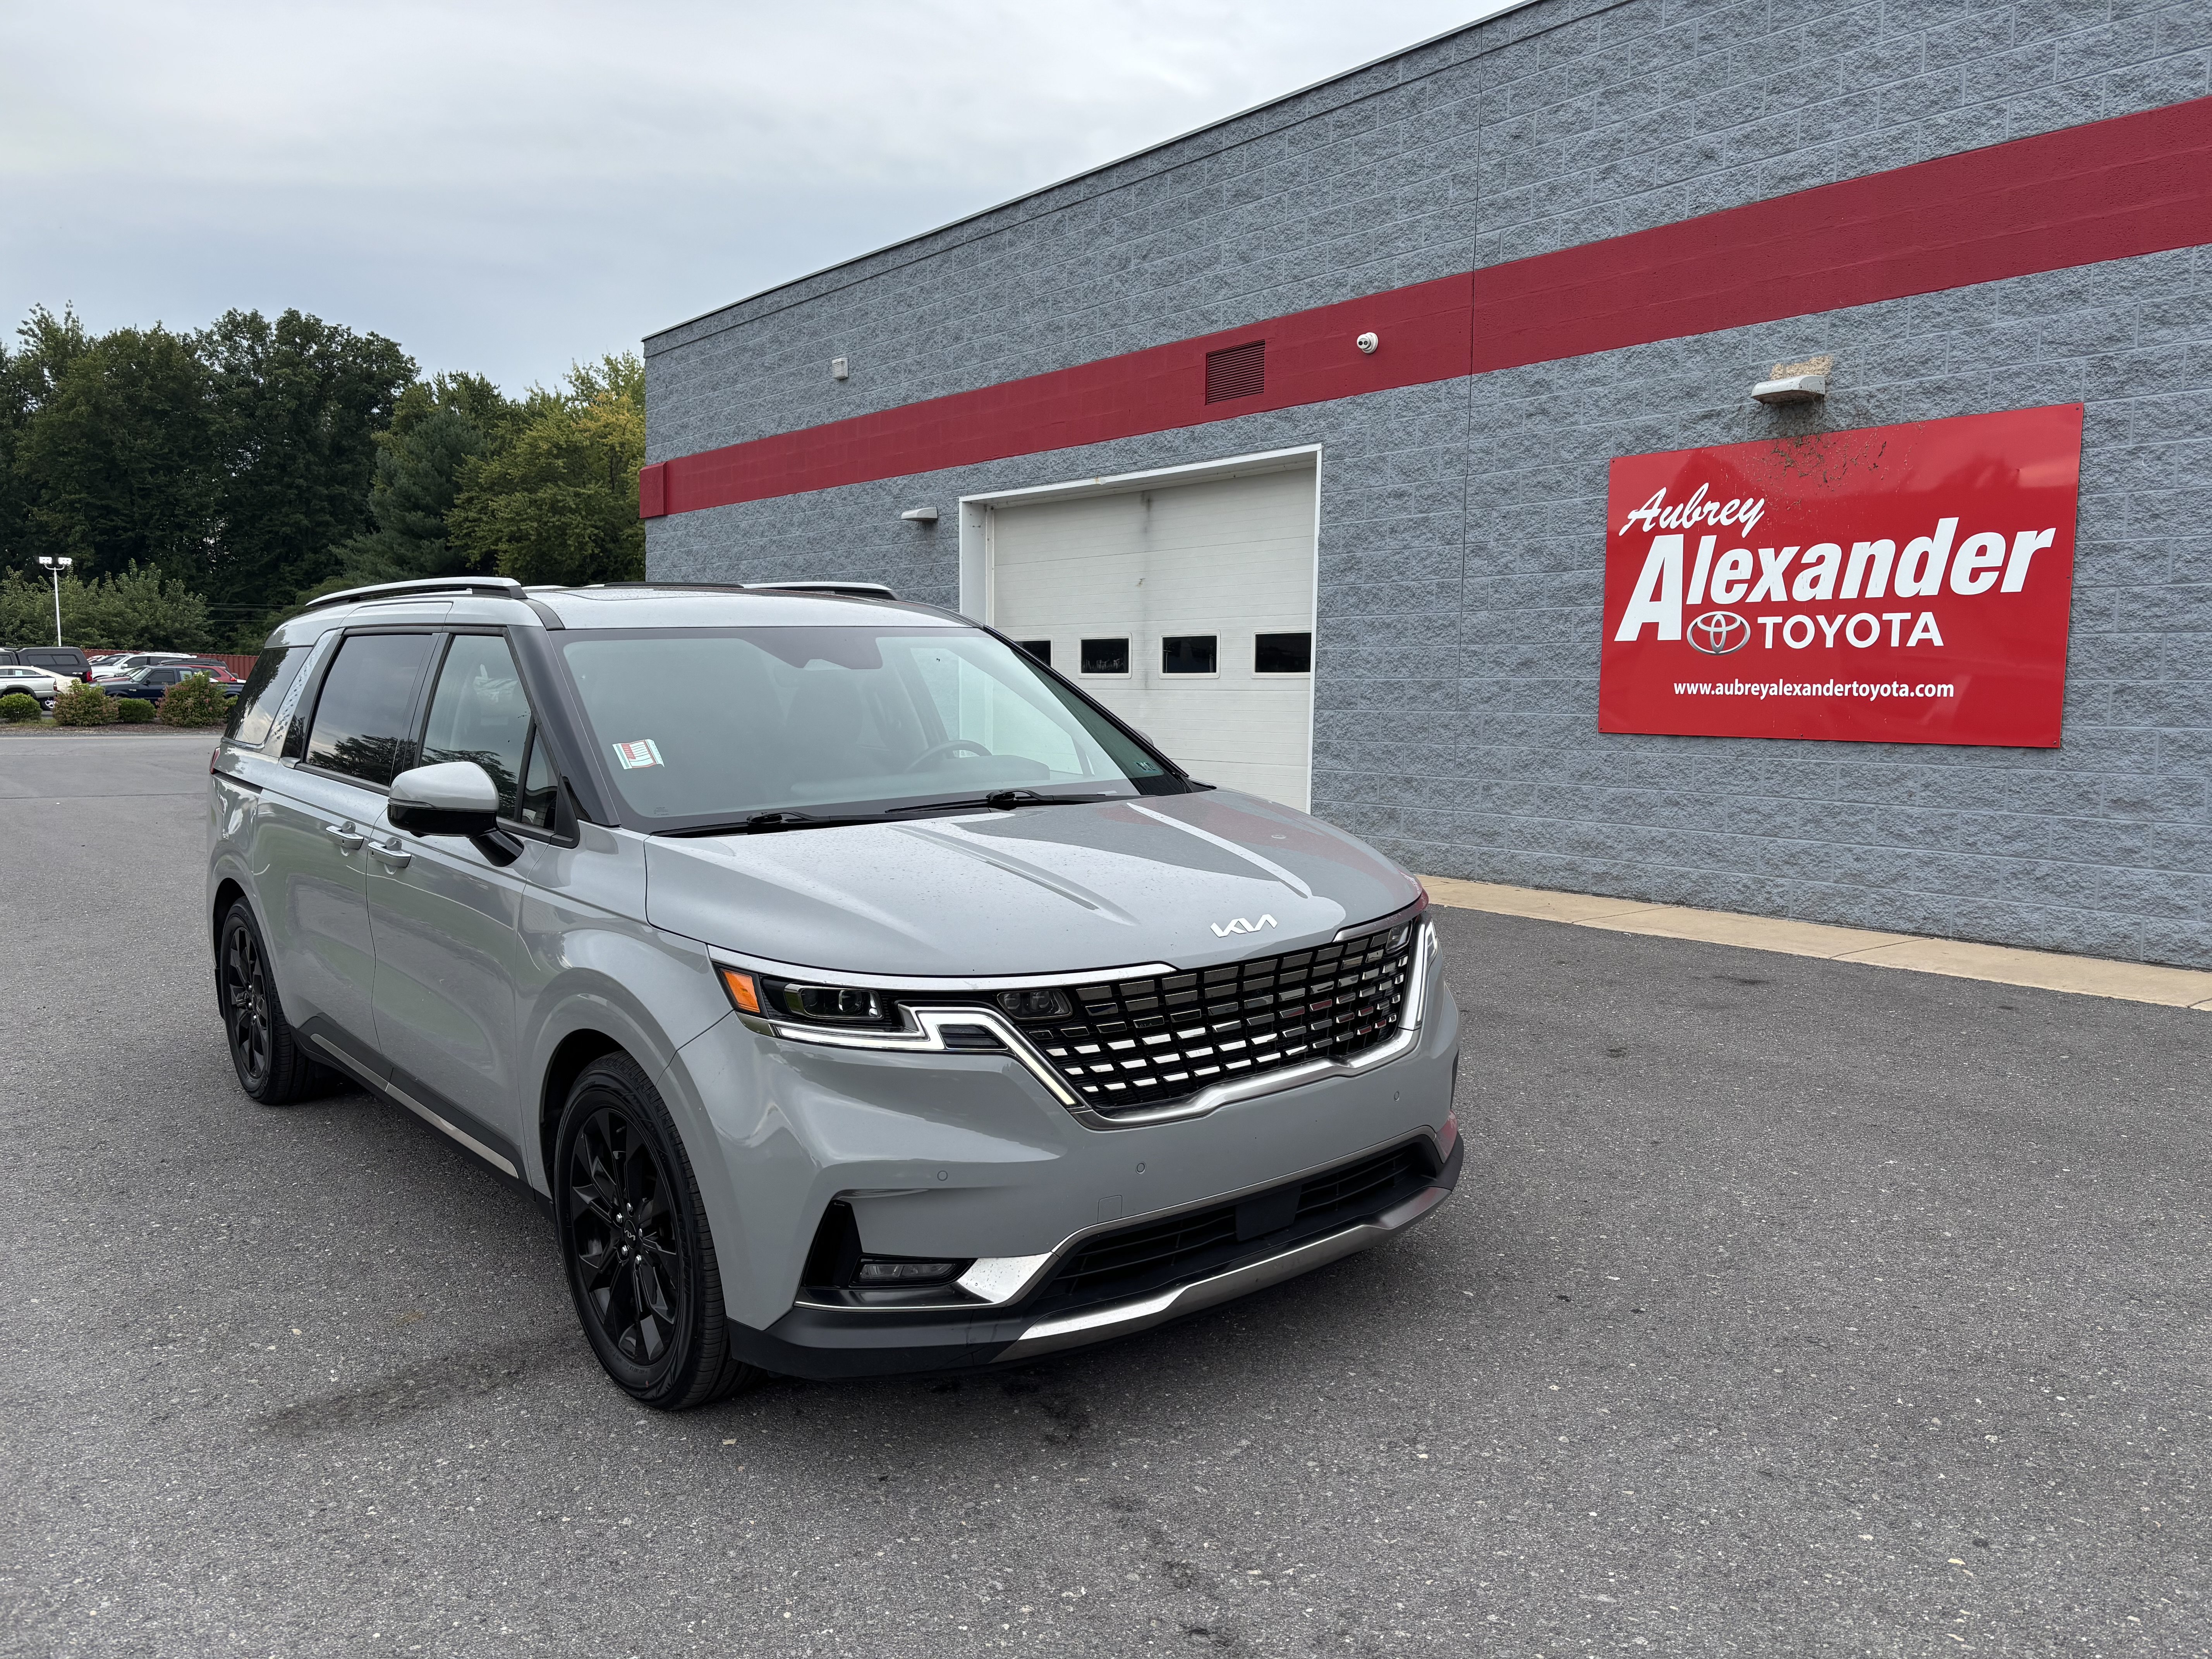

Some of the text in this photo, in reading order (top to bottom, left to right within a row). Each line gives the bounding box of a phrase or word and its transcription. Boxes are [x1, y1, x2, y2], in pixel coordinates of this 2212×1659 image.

[1618, 482, 1765, 538] Aubrey
[1614, 517, 2056, 642] Alexander
[1757, 611, 1944, 649] TOYOTA
[1673, 678, 1954, 701] www.aubreyalexandertoyota.com
[1210, 914, 1278, 938] KIA
